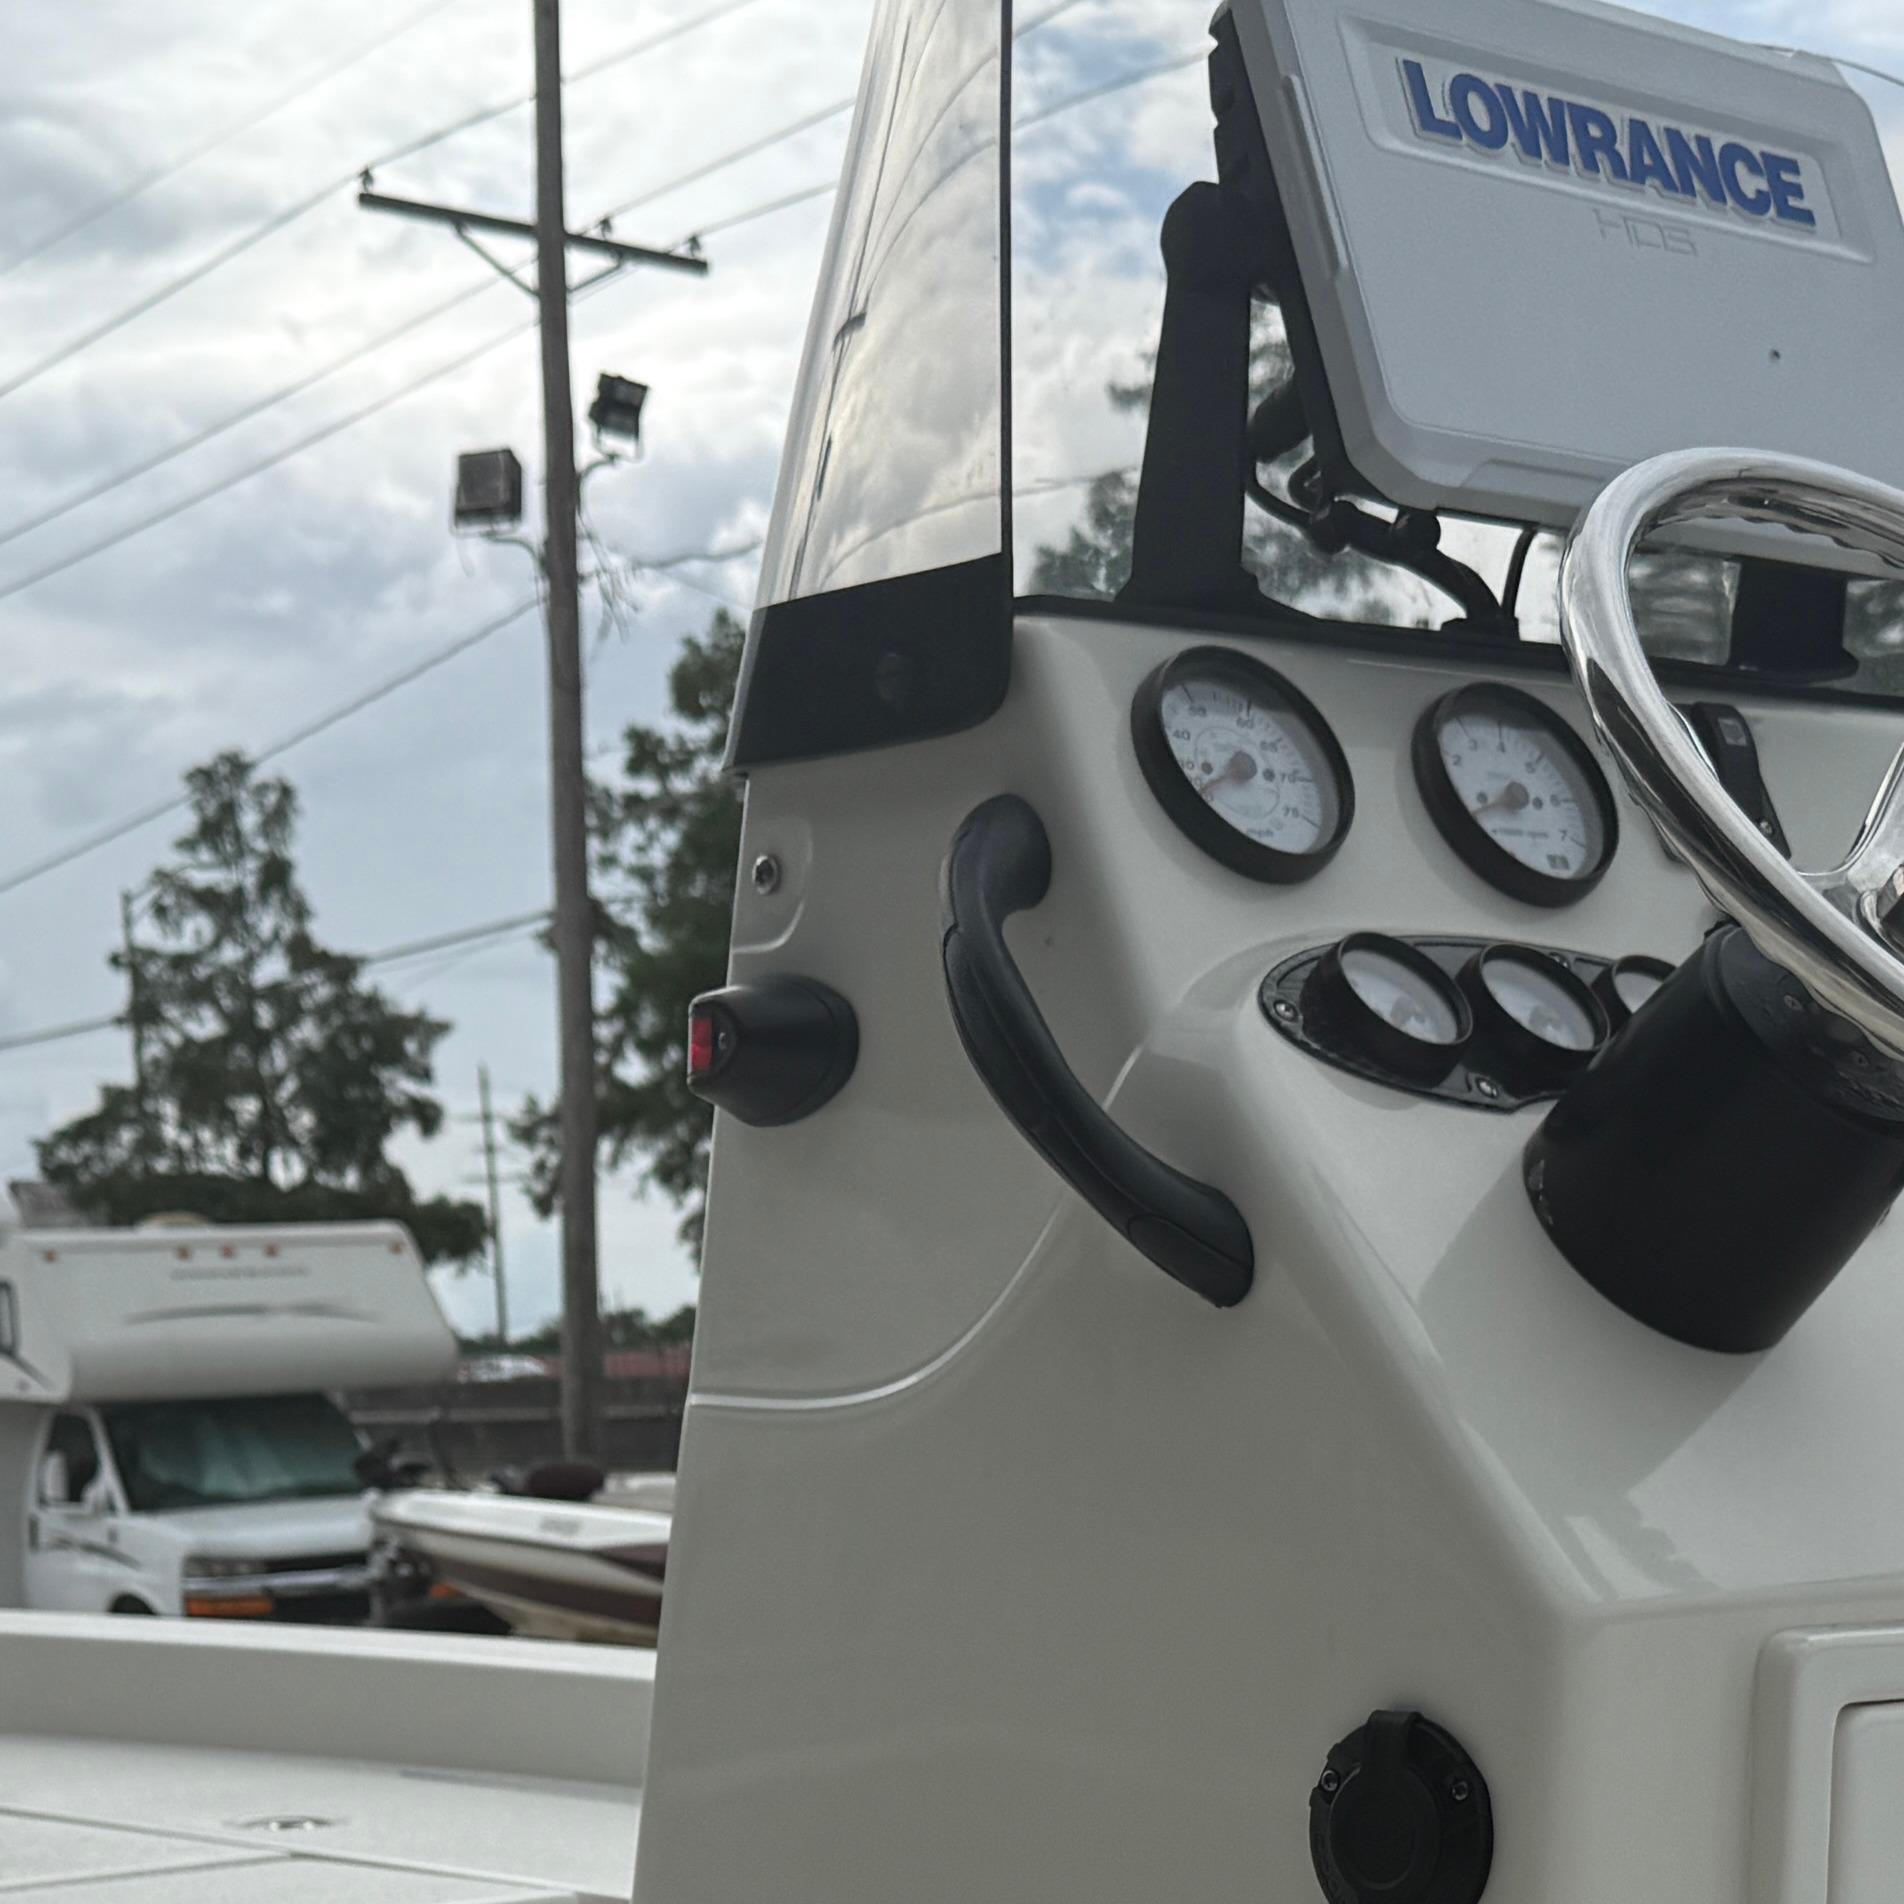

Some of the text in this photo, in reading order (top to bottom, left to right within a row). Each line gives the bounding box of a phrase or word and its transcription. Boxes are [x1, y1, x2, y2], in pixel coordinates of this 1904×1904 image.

[1401, 58, 1817, 228] LOWRANCE
[1592, 207, 1699, 258] HDS
[1172, 729, 1191, 741] 40
